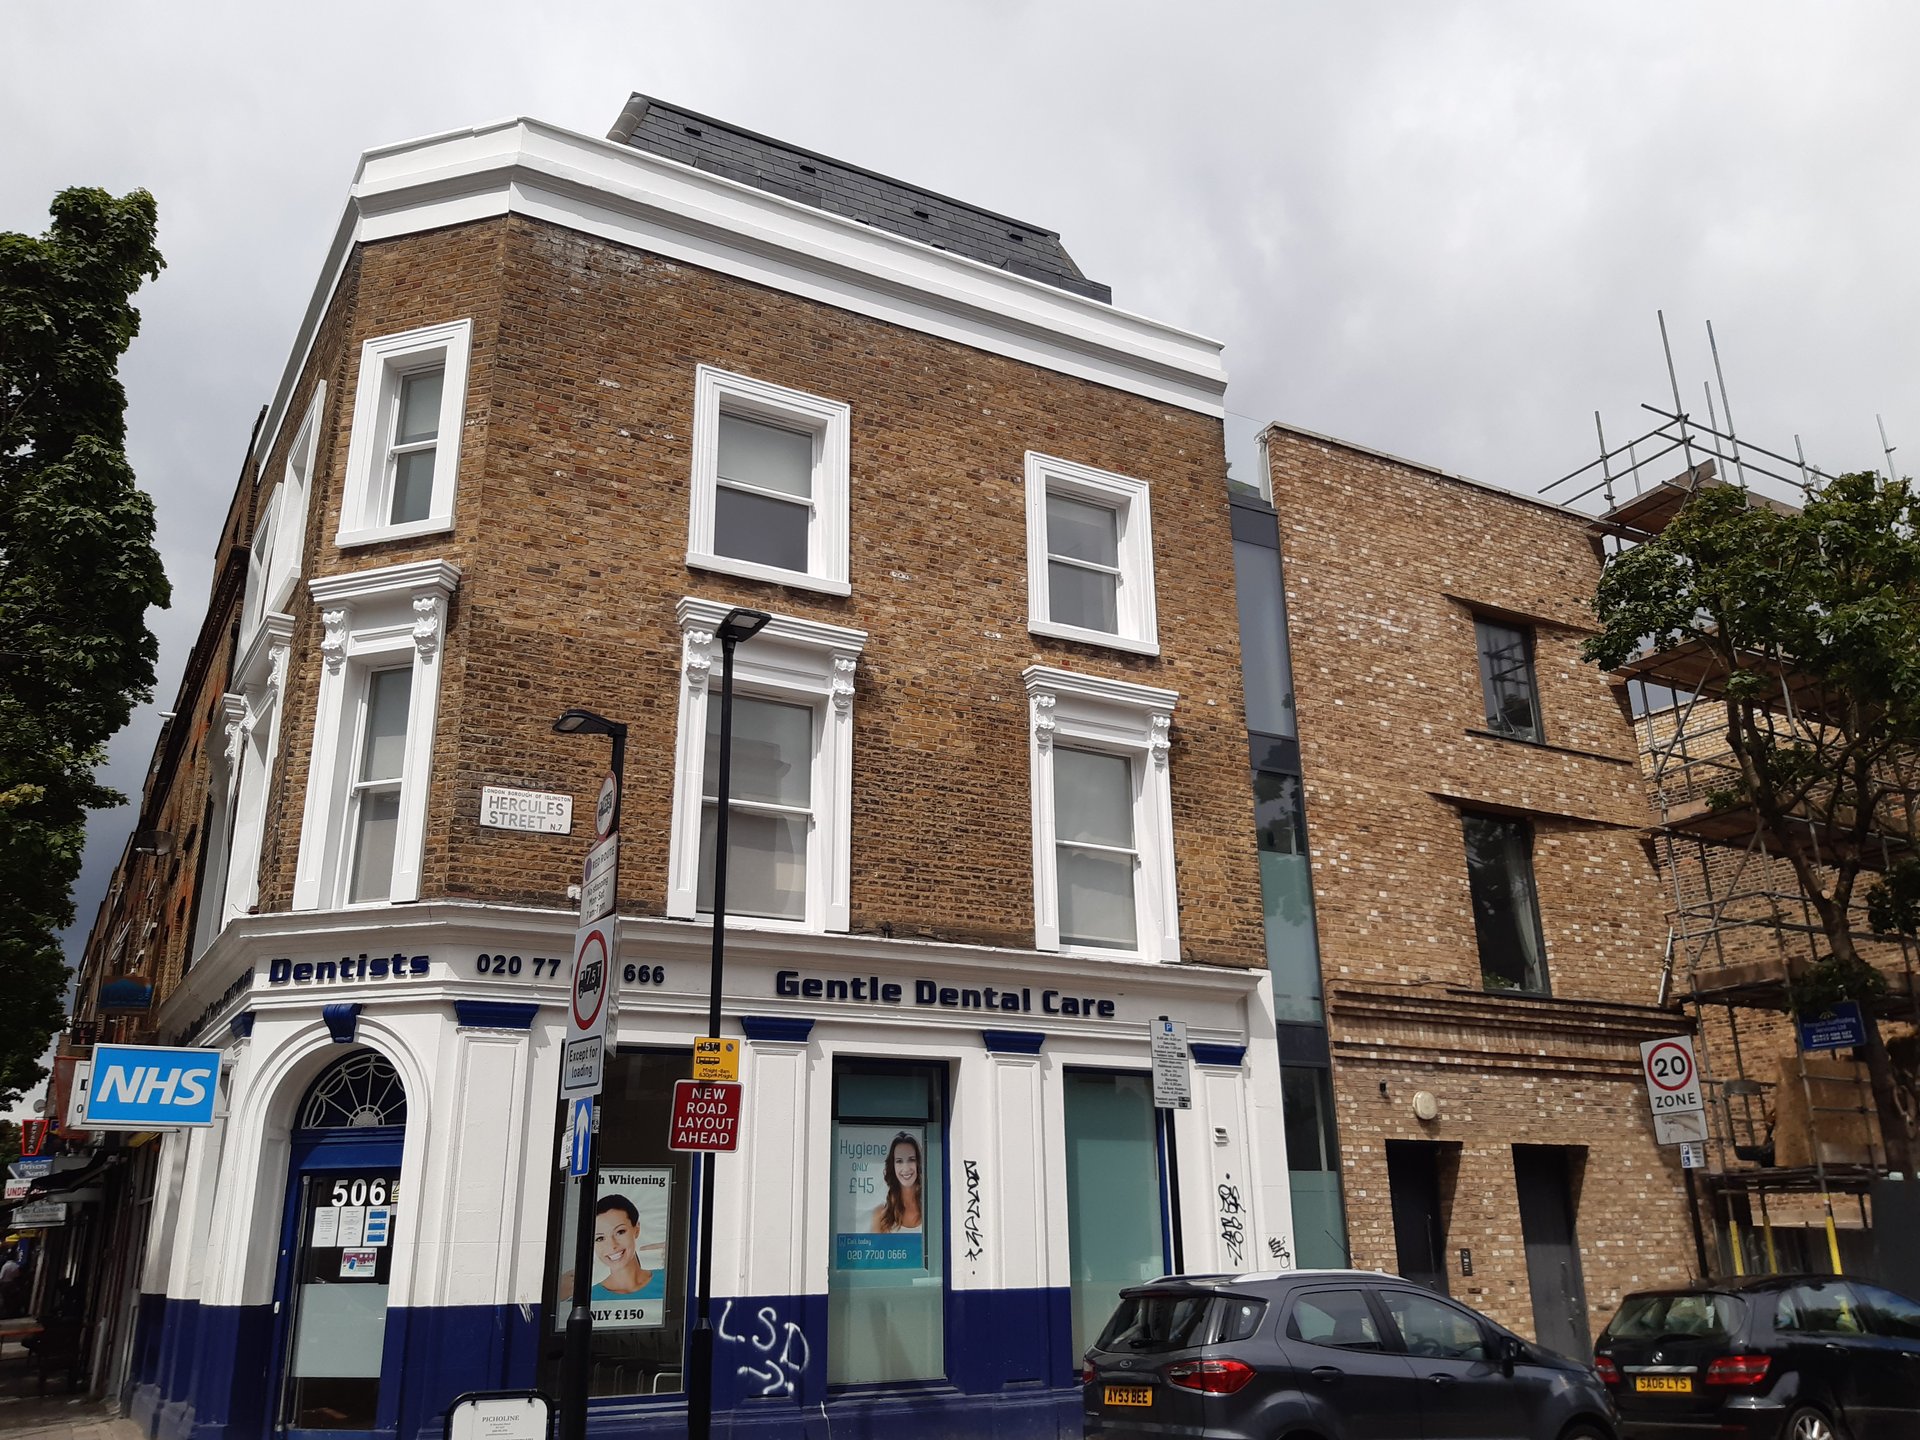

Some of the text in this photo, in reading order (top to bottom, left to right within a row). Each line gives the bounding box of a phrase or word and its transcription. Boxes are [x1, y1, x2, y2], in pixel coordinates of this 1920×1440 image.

[507, 790, 533, 799] BOROUGH
[544, 794, 572, 803] ISLINGTON
[488, 795, 565, 817] HERCULES
[488, 810, 547, 830] STREET
[269, 953, 431, 984] Dentists
[476, 953, 666, 984] 020 77 666
[776, 970, 1116, 1017] Gentle Dental Care
[569, 1045, 598, 1063] Except for
[571, 1063, 593, 1079] loading
[1654, 1055, 1686, 1078] 20
[96, 1065, 212, 1106] NHS
[691, 1087, 726, 1100] NEW
[686, 1101, 728, 1115] ROAD
[1654, 1092, 1697, 1109] ZONE
[677, 1116, 735, 1130] LAYOUT
[677, 1131, 730, 1145] AHEAD
[840, 1140, 888, 1160] Hygiene
[851, 1162, 869, 1172] ONLY
[608, 1174, 666, 1188] Whitening
[849, 1177, 875, 1194] £45
[331, 1177, 387, 1207] 506
[847, 1250, 907, 1260] 020 7700 0666
[591, 1309, 645, 1321] NLY £150
[1640, 1377, 1687, 1390] SA06 LYS
[1107, 1388, 1149, 1405] AY53 BEE
[481, 1414, 520, 1423] PICHOLINE
